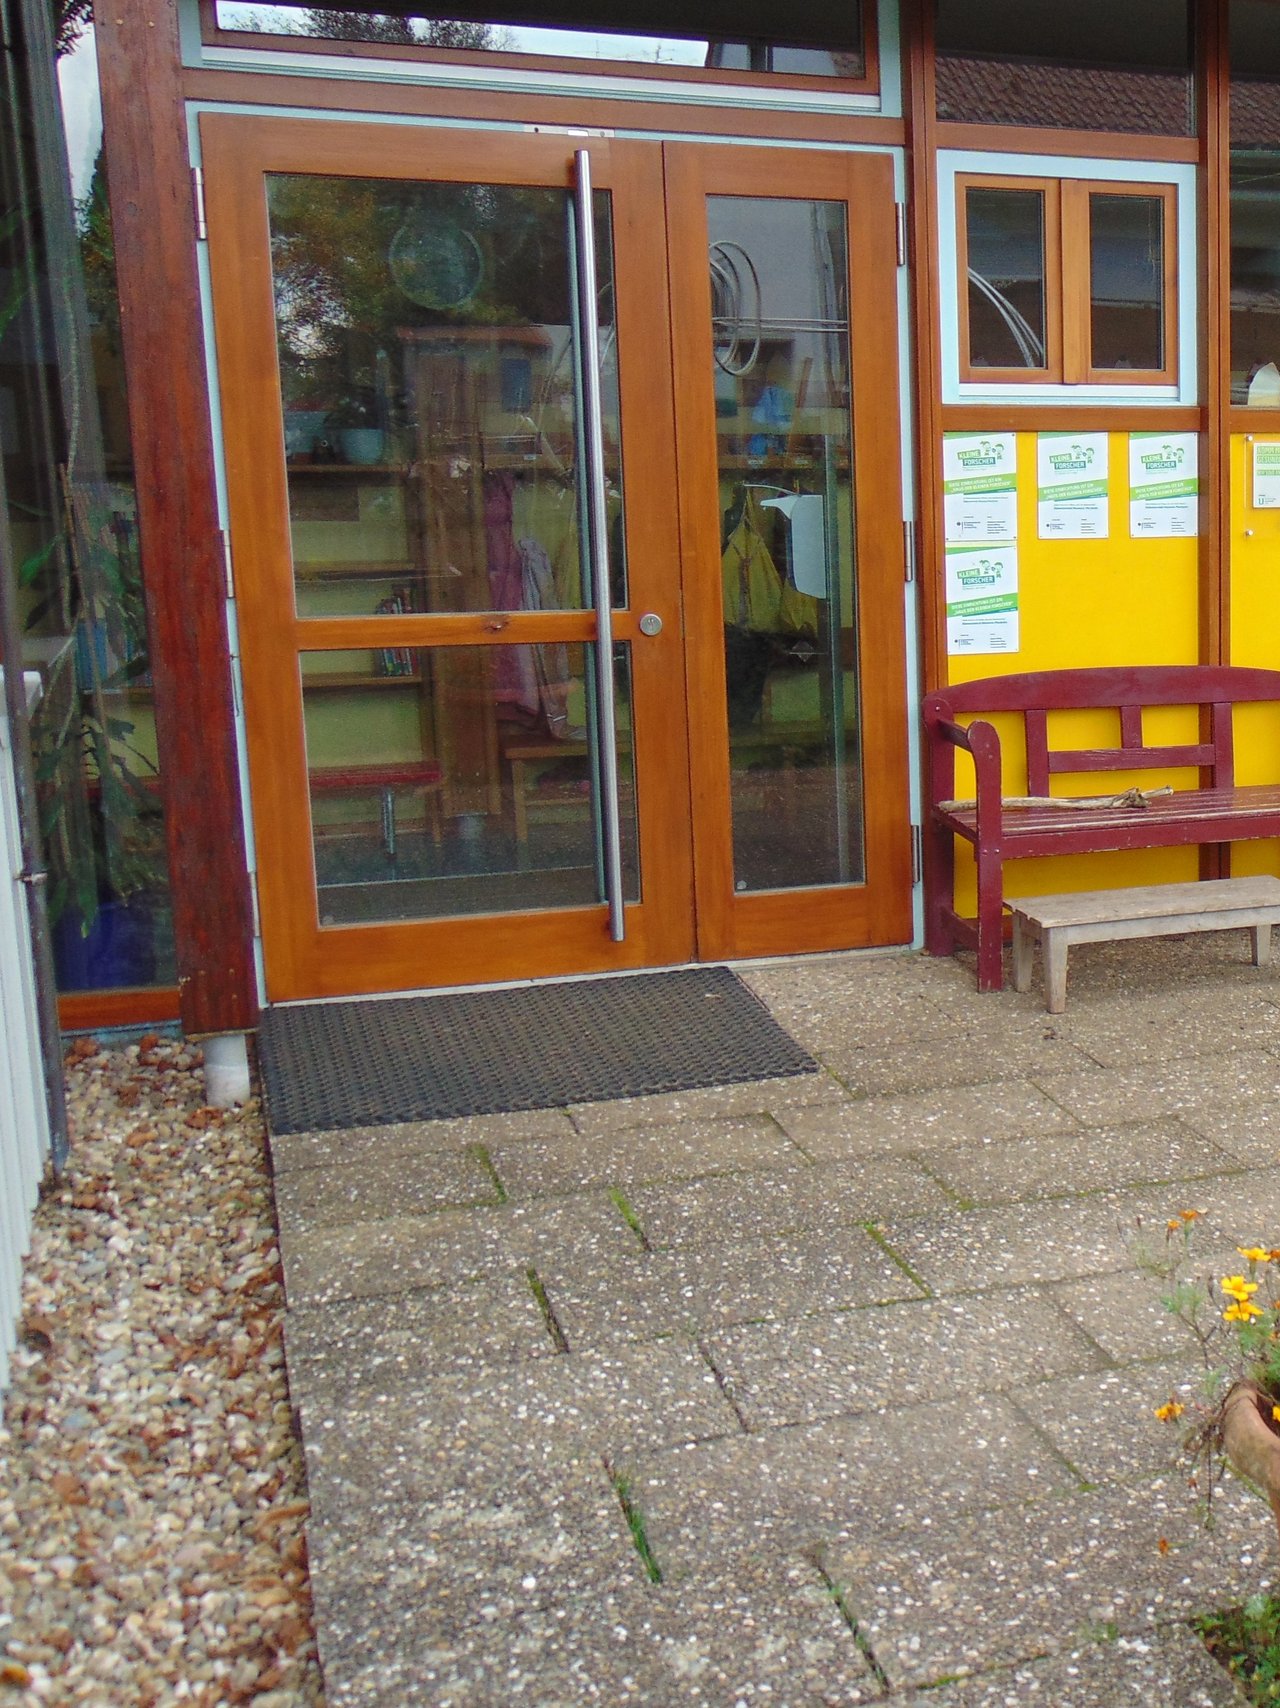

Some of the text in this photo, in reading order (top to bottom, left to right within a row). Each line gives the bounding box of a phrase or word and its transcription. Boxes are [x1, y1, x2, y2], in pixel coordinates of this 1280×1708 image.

[959, 450, 979, 458] KLEINE
[1051, 454, 1071, 462] KLEINE
[1142, 454, 1162, 462] KLEINE
[1056, 461, 1085, 469] FORSCHER
[959, 569, 979, 578] KLEINE
[964, 576, 994, 584] FORSCHER
